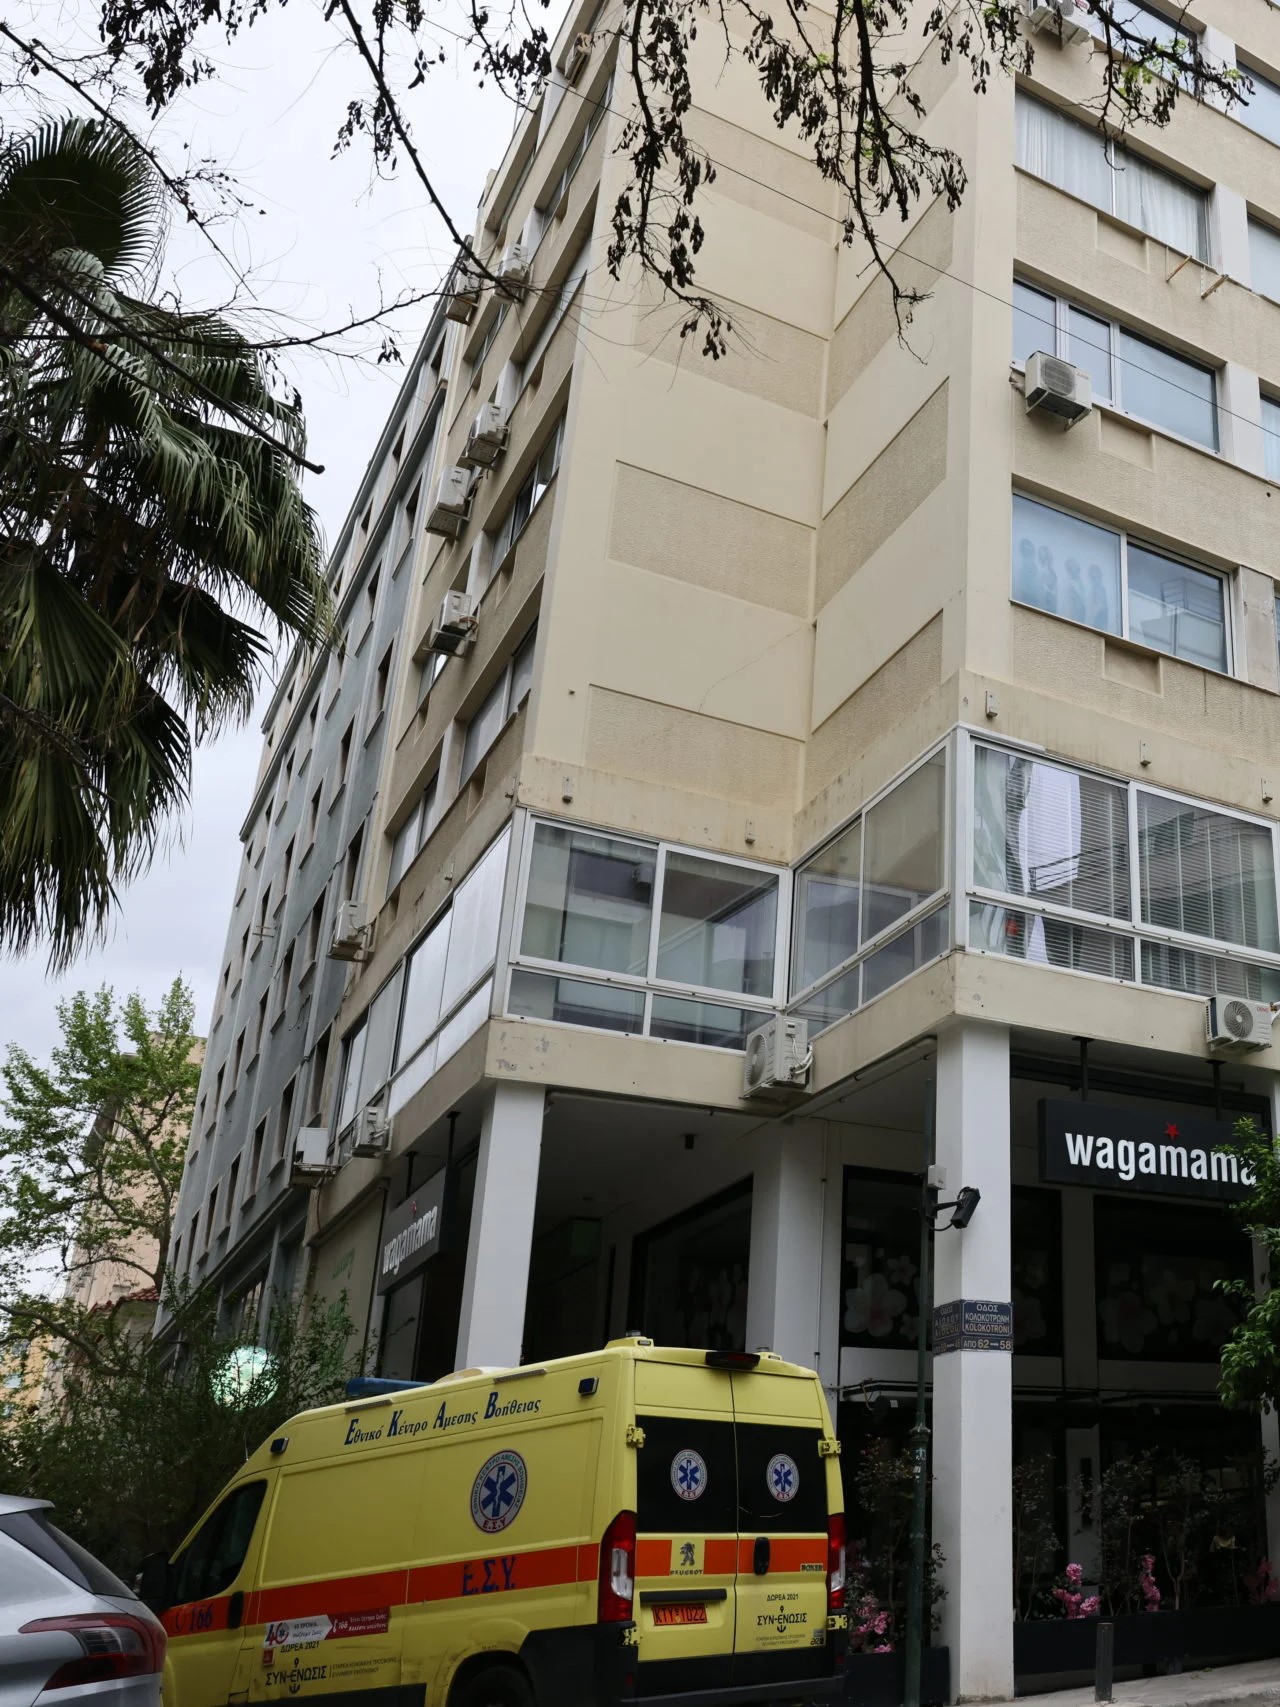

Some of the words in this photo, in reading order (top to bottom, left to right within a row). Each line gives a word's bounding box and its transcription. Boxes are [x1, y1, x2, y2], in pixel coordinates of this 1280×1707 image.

[976, 1303, 999, 1312] ΟΔΟΣ
[965, 1312, 1010, 1323] ΚΟΛΟΚΟΤΡΩΝΗ
[964, 1322, 1010, 1334] KOLOKOTRONI
[963, 1340, 977, 1348] ΑΠΟ
[344, 1418, 383, 1445] Εθνικό
[387, 1409, 428, 1437] Κέντρο
[432, 1401, 478, 1430] Αμεσης
[484, 1391, 541, 1421] Βοήθειας
[801, 1563, 824, 1572] BOXER
[766, 1593, 786, 1602] ΔΩΡΕΑ
[280, 1642, 304, 1653] ΔΩΡΕΑ
[304, 1641, 320, 1650] 2021
